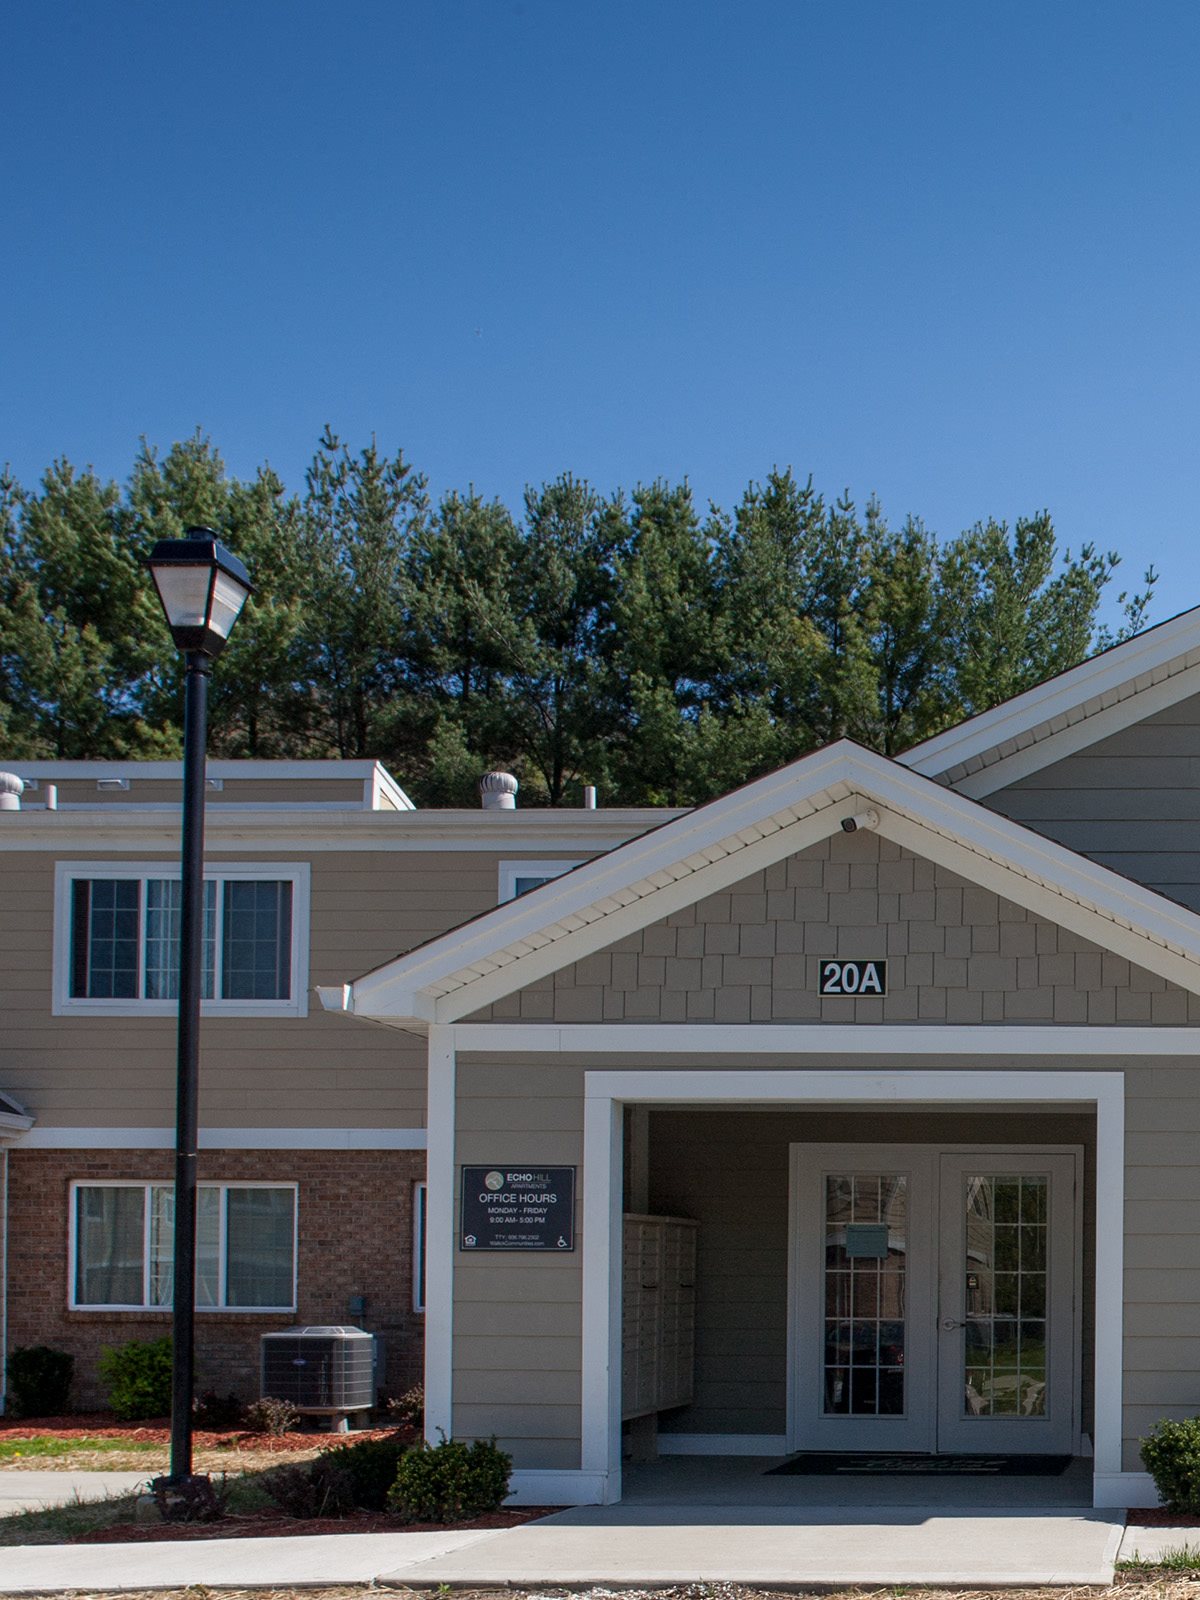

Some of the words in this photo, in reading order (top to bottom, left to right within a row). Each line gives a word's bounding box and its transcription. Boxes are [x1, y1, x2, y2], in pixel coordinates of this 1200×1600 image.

[823, 962, 882, 993] 20A
[506, 1173, 533, 1182] ECHO
[533, 1173, 552, 1182] HILL
[479, 1193, 517, 1203] OFFICE
[519, 1193, 557, 1203] HOURS
